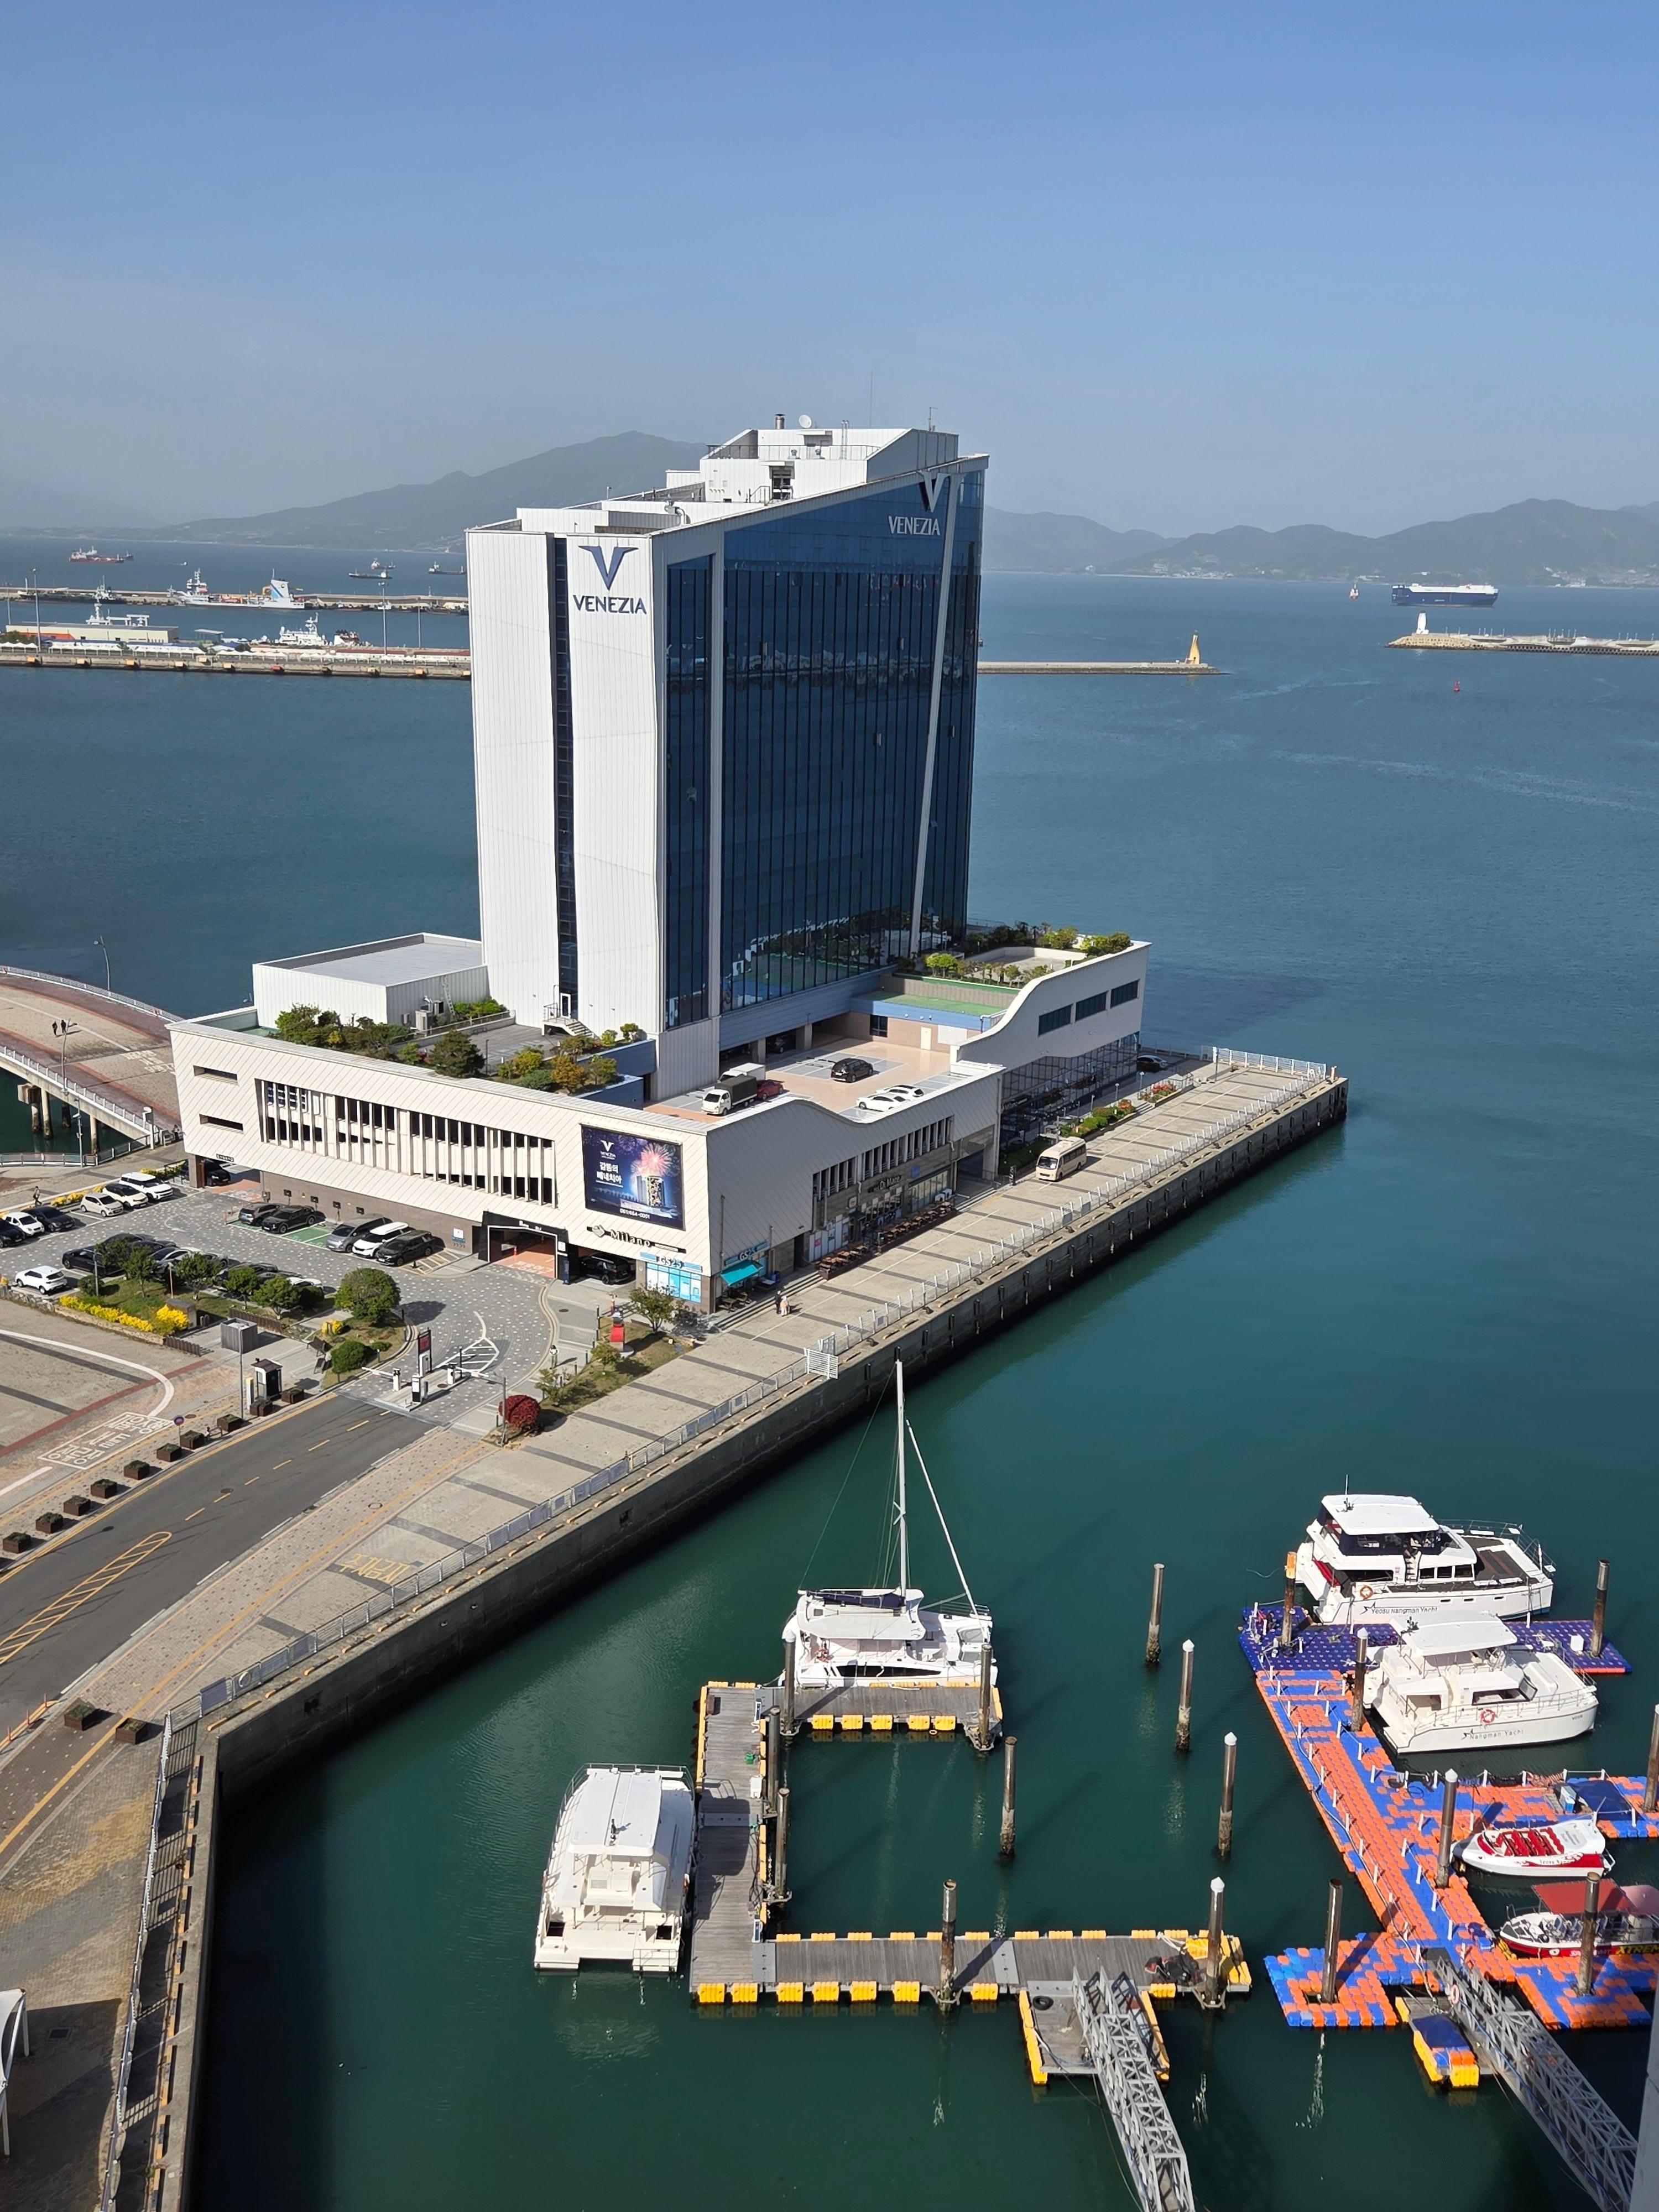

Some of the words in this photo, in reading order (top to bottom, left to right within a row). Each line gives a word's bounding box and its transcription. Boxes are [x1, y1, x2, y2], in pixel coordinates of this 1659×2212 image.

[888, 515, 941, 536] VENEZIA
[572, 594, 647, 615] VENEZIA
[610, 1229, 651, 1248] Milano
[739, 1246, 756, 1261] GS25
[659, 1256, 685, 1269] GS25
[1470, 1731, 1501, 1740] Nangman
